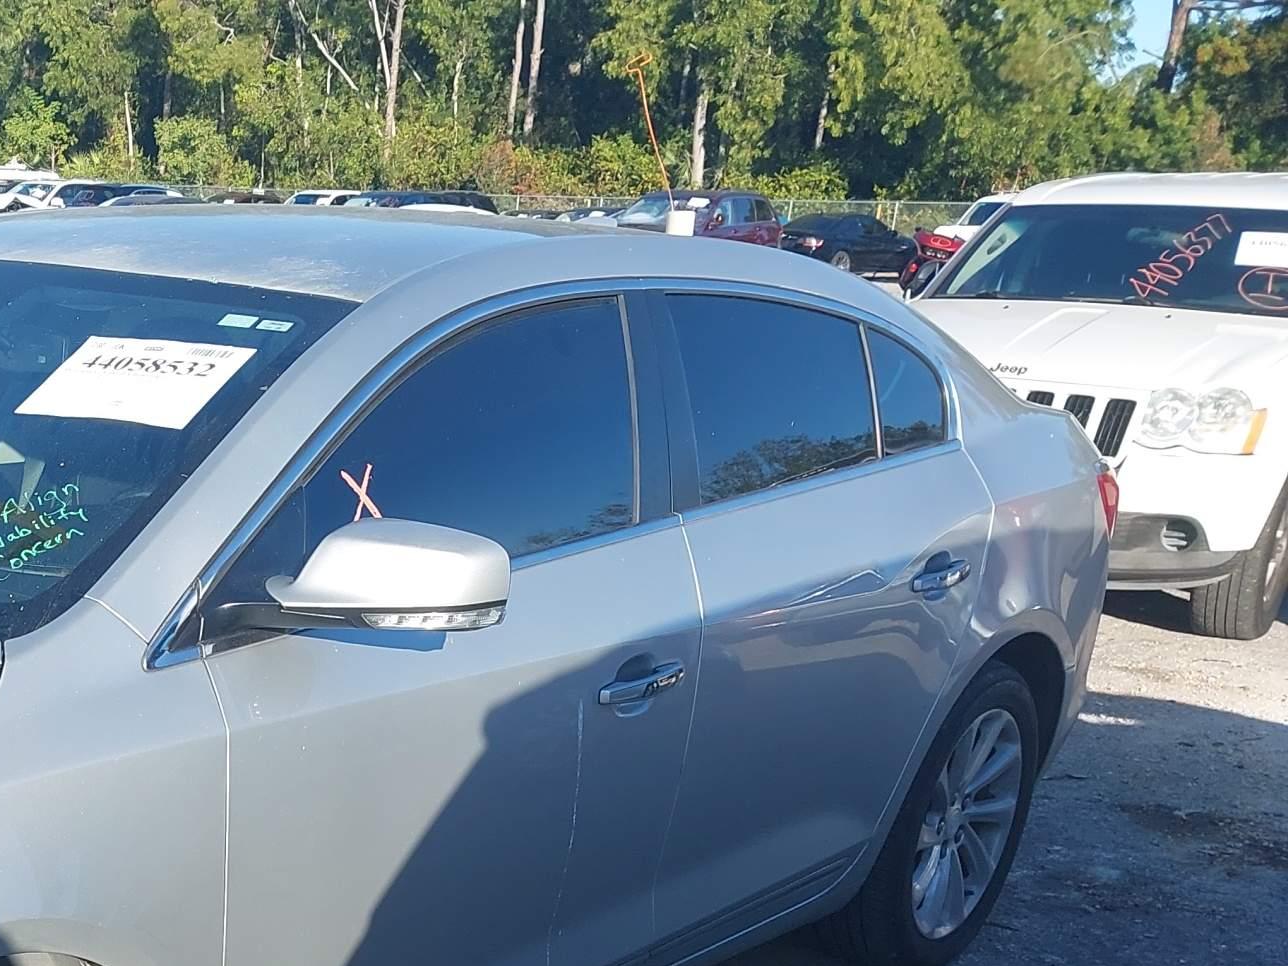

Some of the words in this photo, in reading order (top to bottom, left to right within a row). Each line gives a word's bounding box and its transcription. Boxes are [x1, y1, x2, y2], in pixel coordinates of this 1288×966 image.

[82, 353, 216, 377] 44058532
[989, 362, 1028, 376] Jeep
[0, 483, 80, 524] Align
